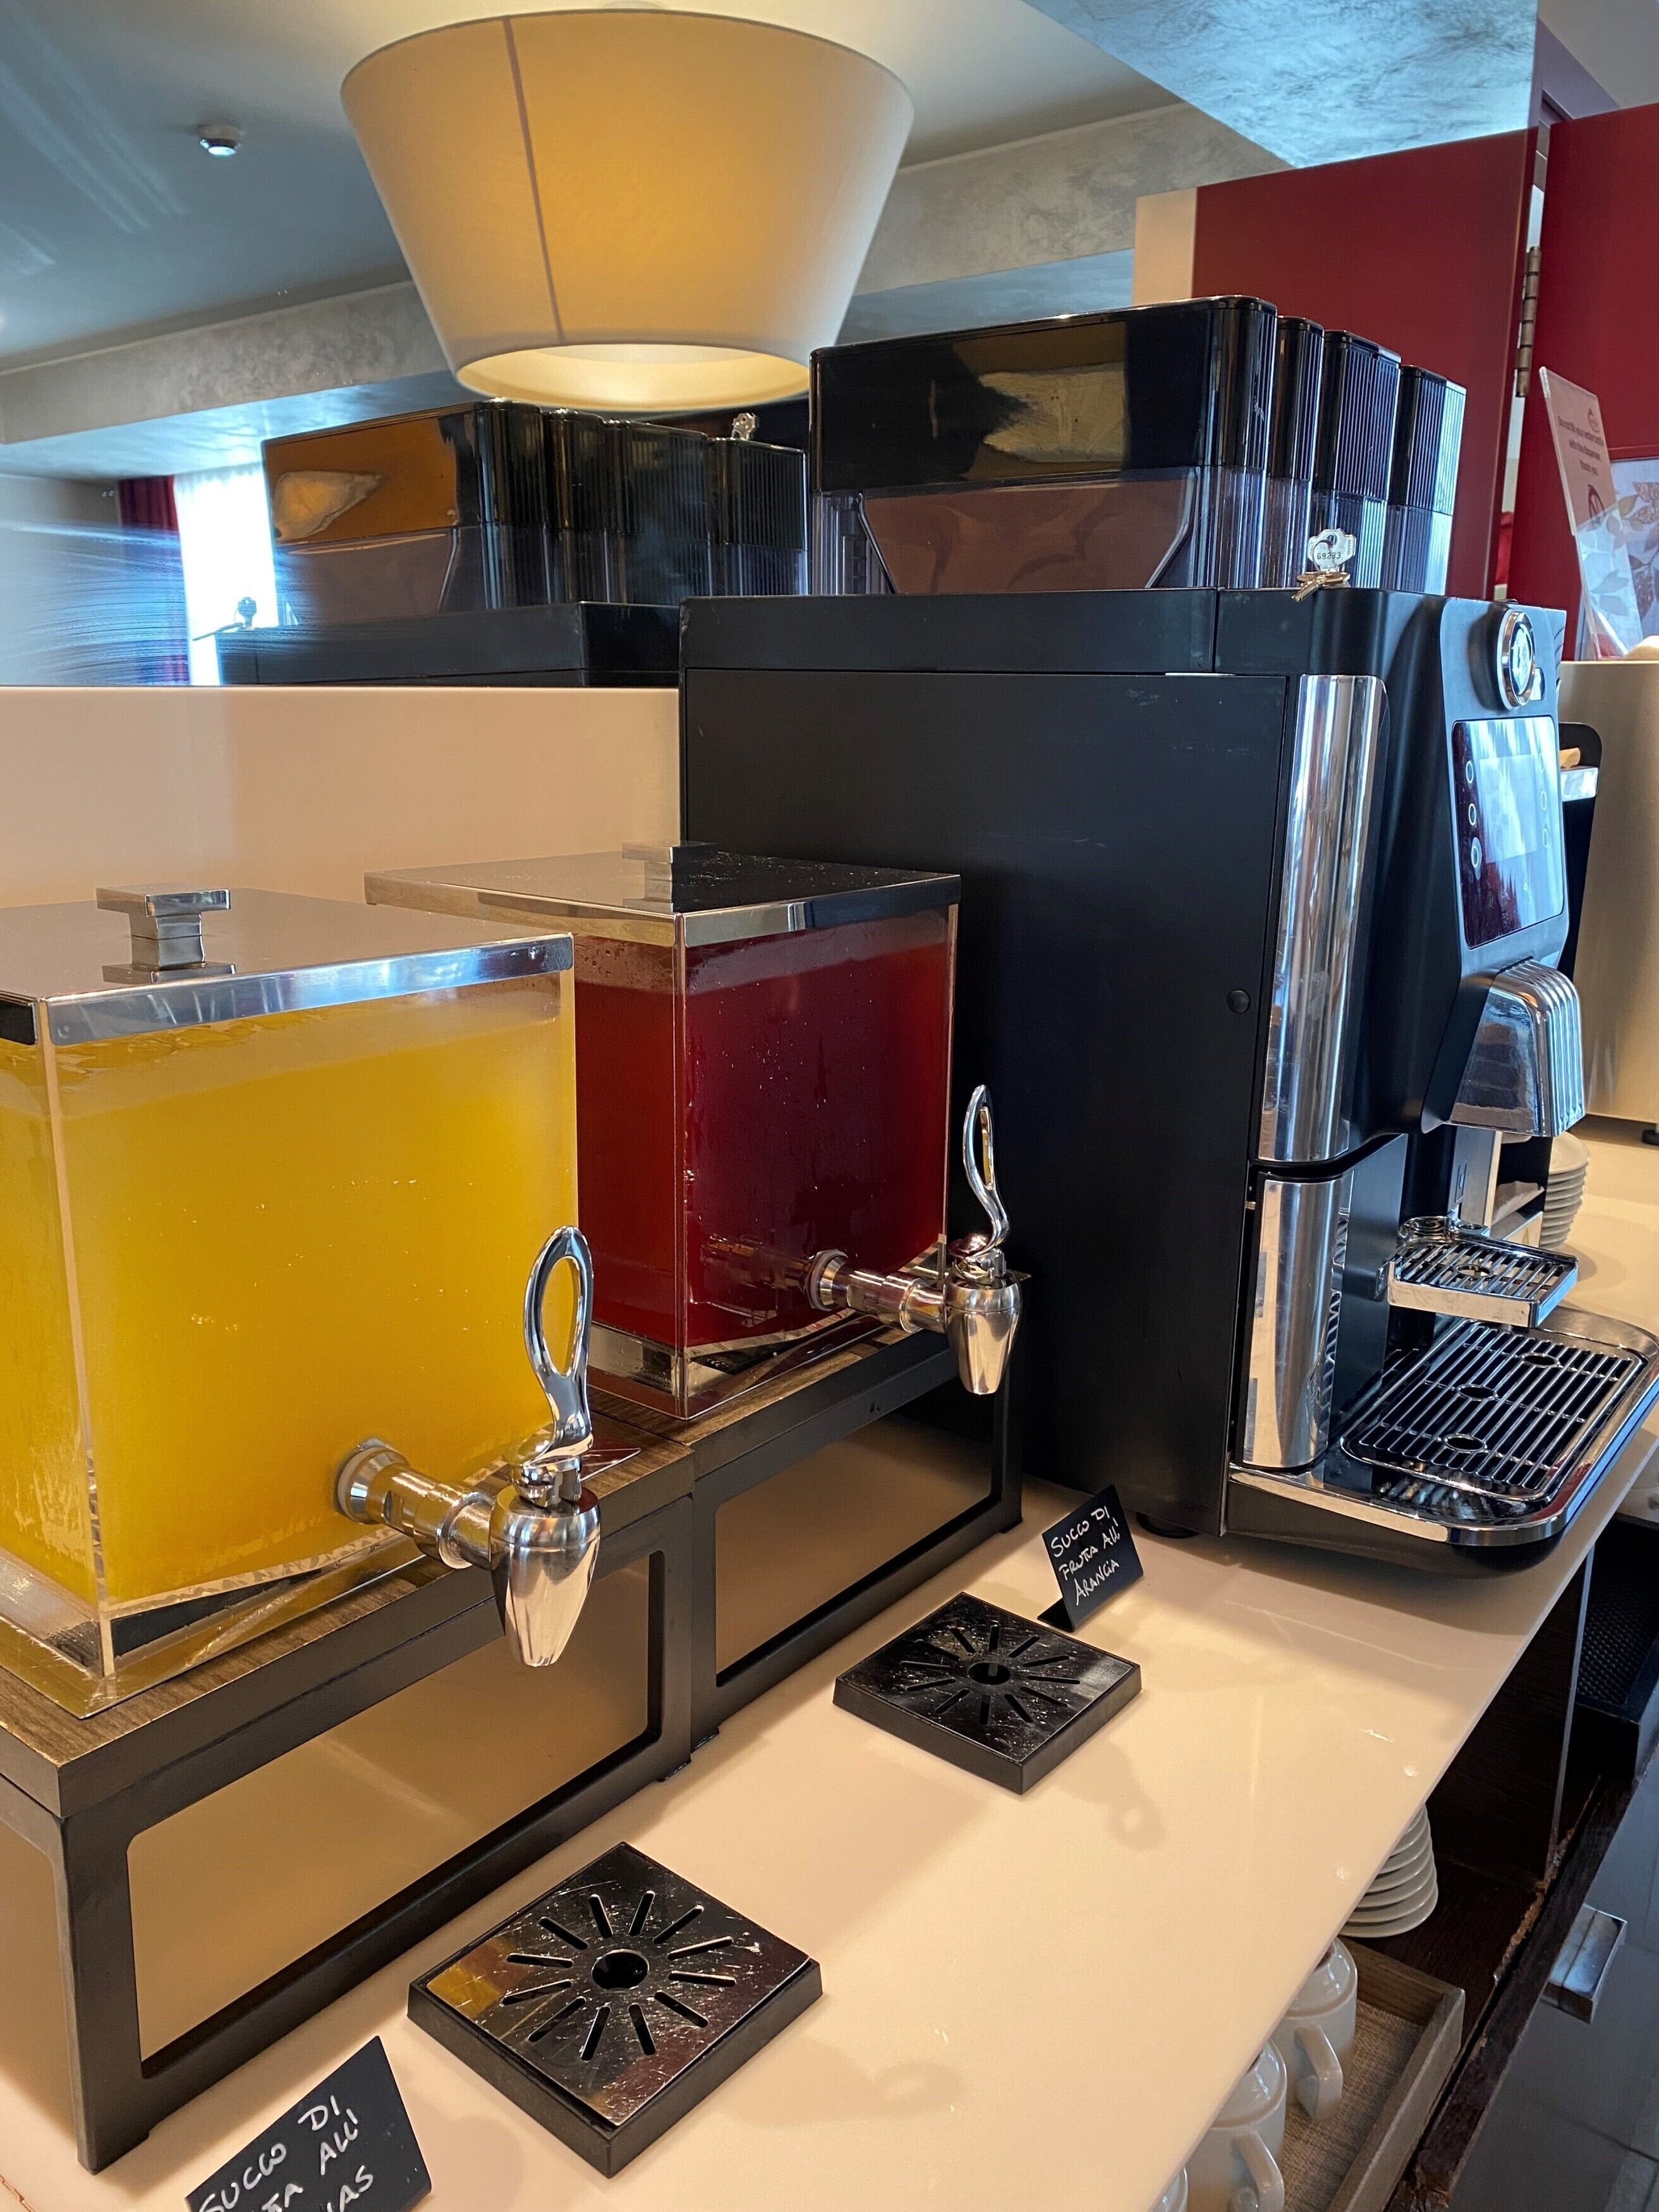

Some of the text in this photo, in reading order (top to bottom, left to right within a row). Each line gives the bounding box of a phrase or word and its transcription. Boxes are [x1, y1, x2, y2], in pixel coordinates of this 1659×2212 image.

[1050, 1506, 1110, 1558] SUCCO DI
[297, 2095, 340, 2131] DI
[327, 2165, 374, 2212] AS
